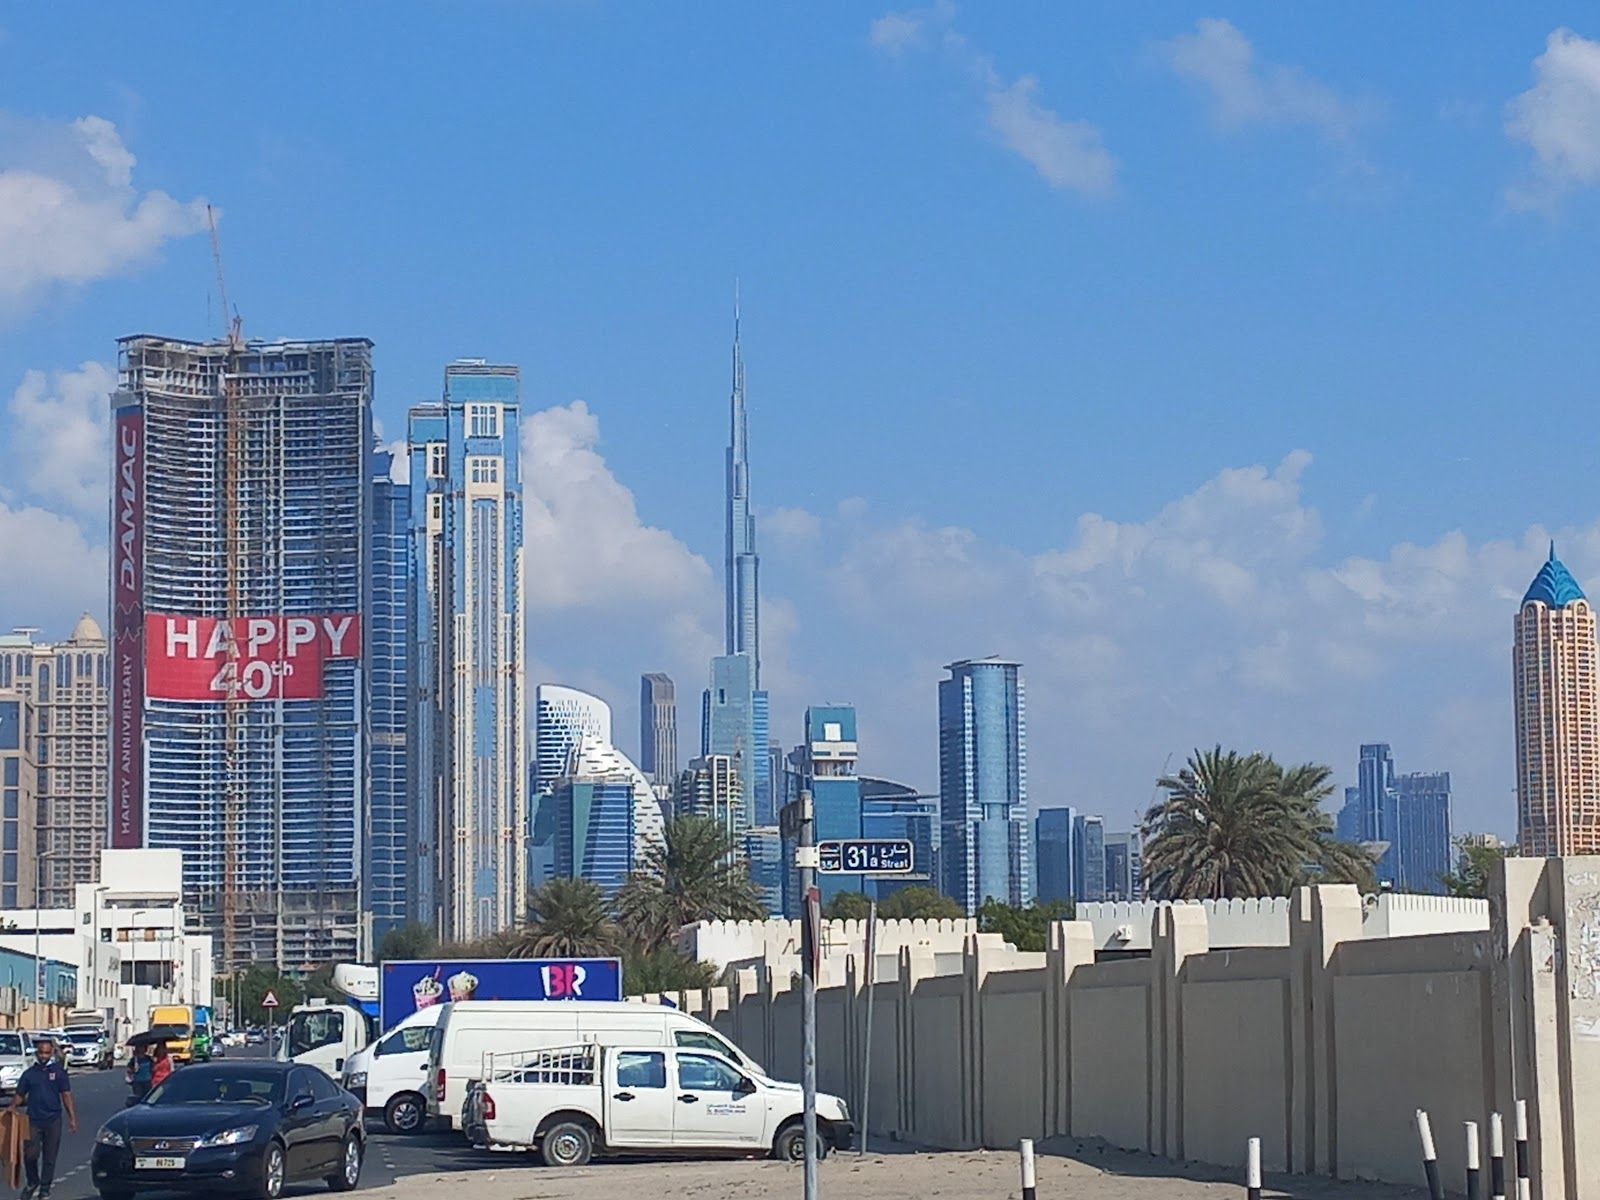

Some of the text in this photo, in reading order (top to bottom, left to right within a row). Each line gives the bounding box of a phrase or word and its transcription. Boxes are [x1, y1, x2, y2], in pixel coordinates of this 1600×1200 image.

[121, 425, 137, 592] DAMAC
[166, 617, 353, 659] HAPPY
[210, 660, 294, 699] 40th
[121, 653, 133, 834] HAPPY ANNIVERSARY
[848, 845, 868, 867] 31
[881, 859, 908, 868] Street
[881, 844, 908, 858] شارع
[540, 964, 586, 997] BR
